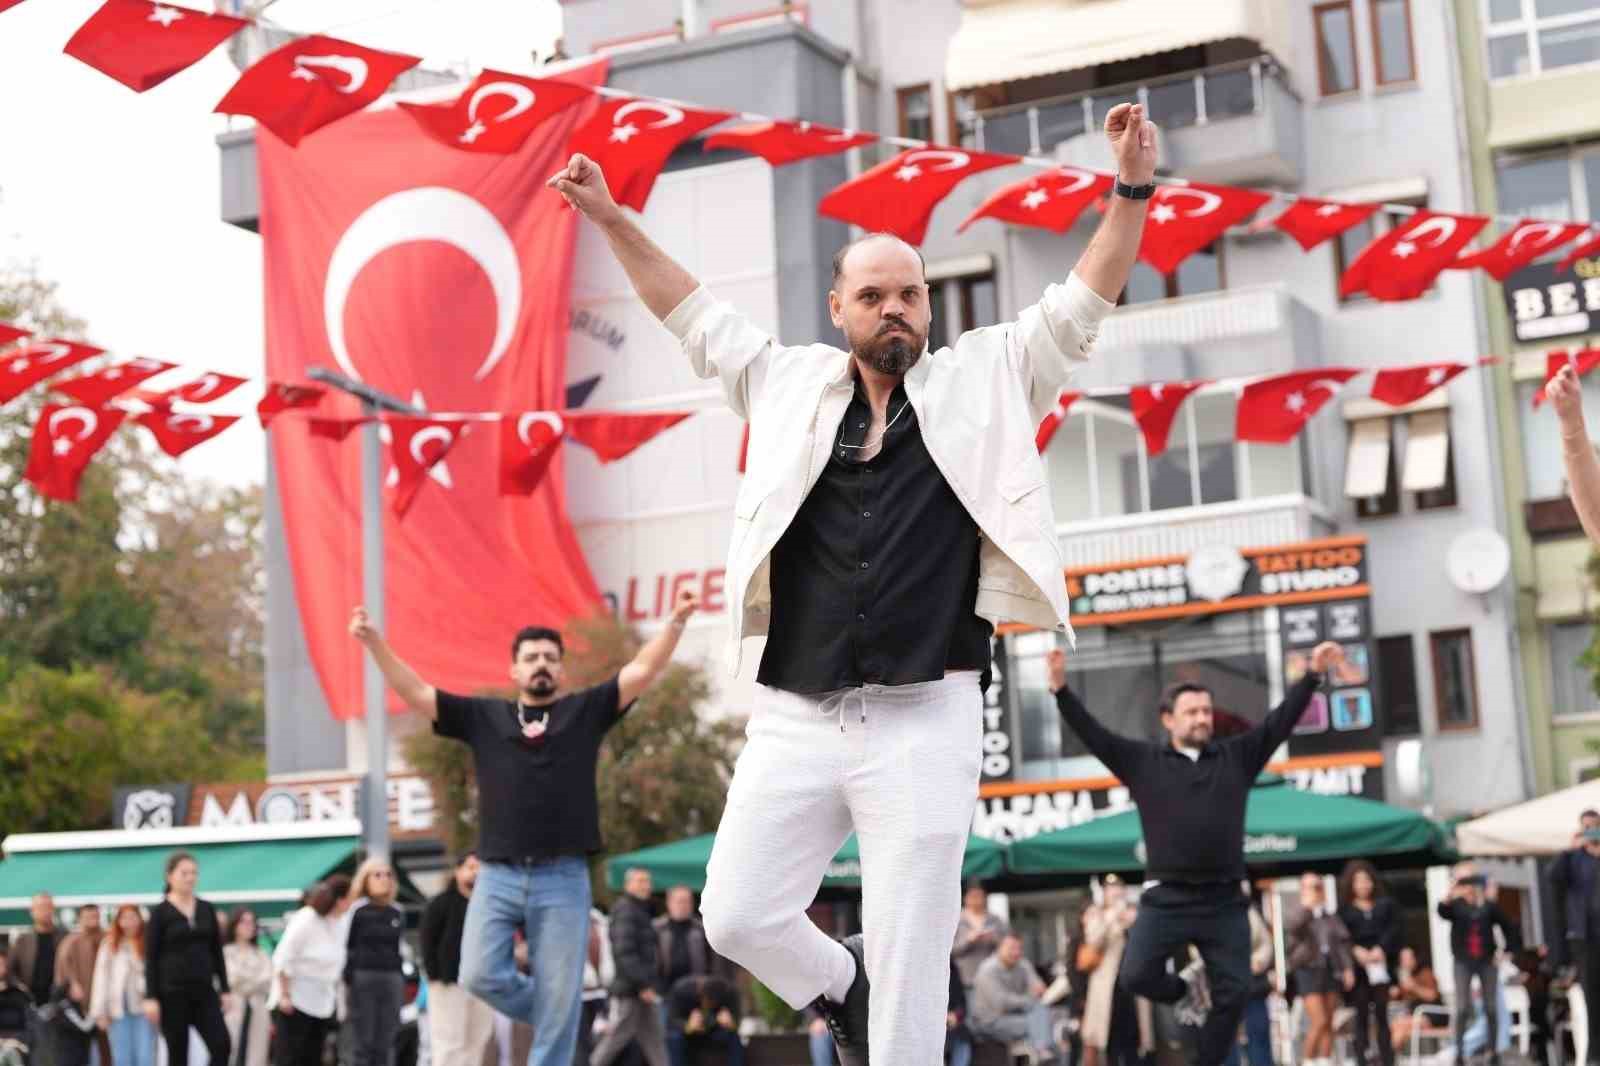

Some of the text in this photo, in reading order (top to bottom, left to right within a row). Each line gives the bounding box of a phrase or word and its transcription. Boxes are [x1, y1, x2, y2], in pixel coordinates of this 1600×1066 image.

[1256, 547, 1362, 575] TATTOO
[1260, 565, 1359, 595] STUDIO
[983, 636, 1010, 777] ATTOO
[201, 777, 434, 829] MONE
